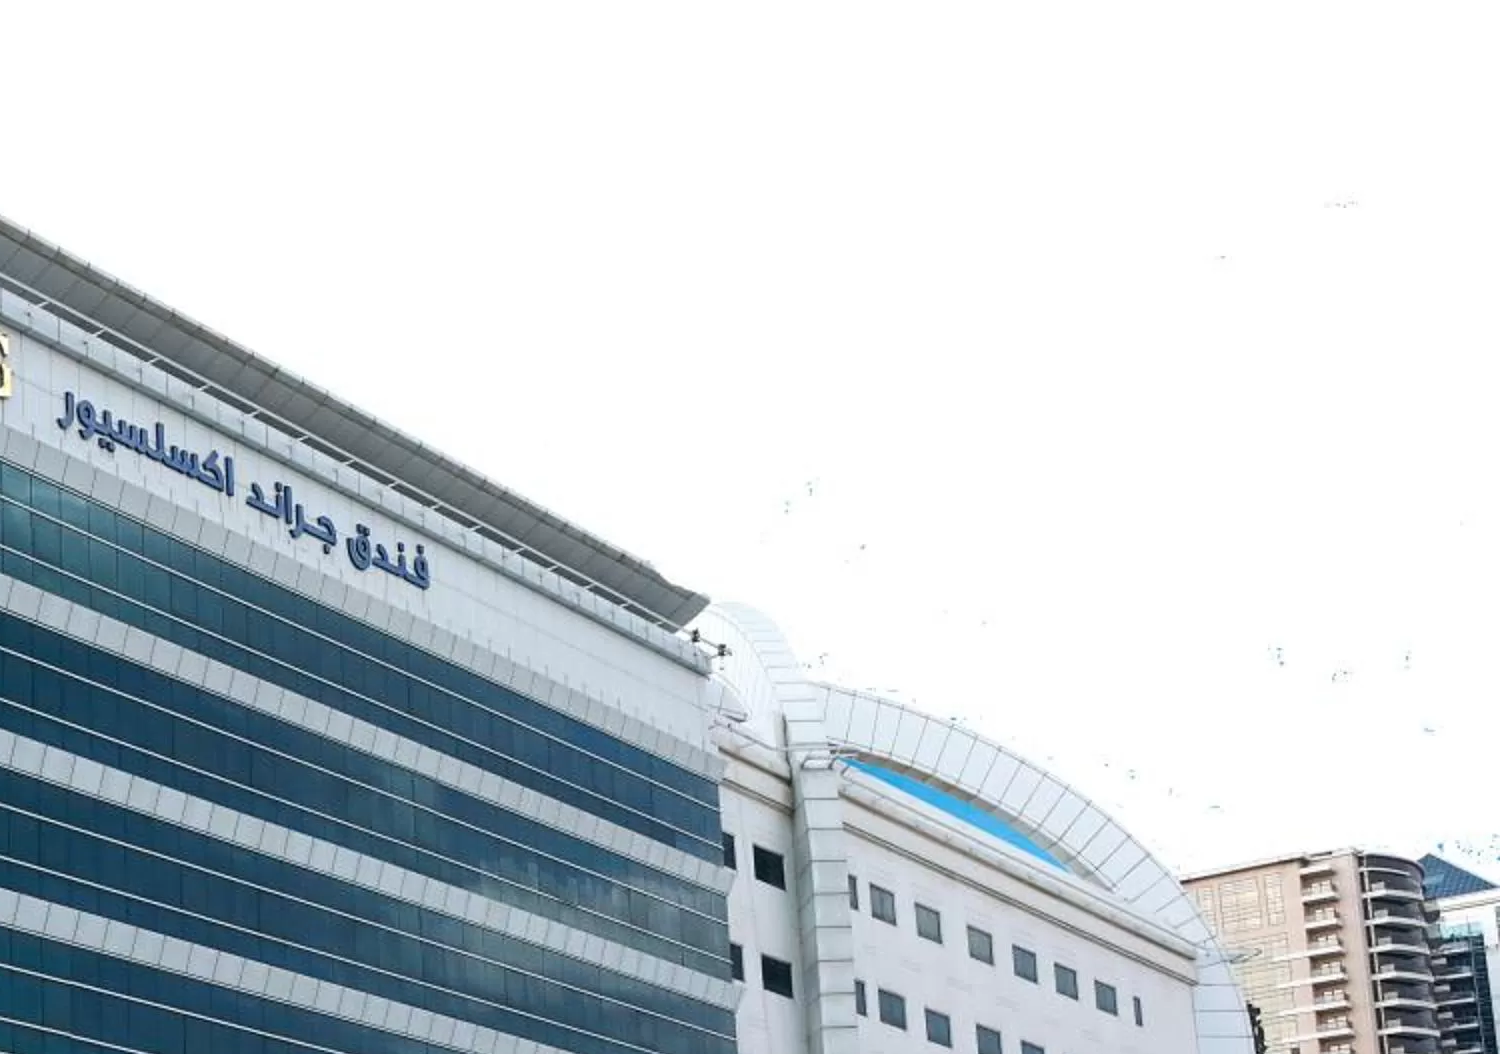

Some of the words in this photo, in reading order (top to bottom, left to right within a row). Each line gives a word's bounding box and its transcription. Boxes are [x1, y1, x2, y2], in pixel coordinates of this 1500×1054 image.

[58, 391, 235, 497] اكسلسيور
[245, 481, 337, 555] جراند
[347, 523, 432, 591] فندق
